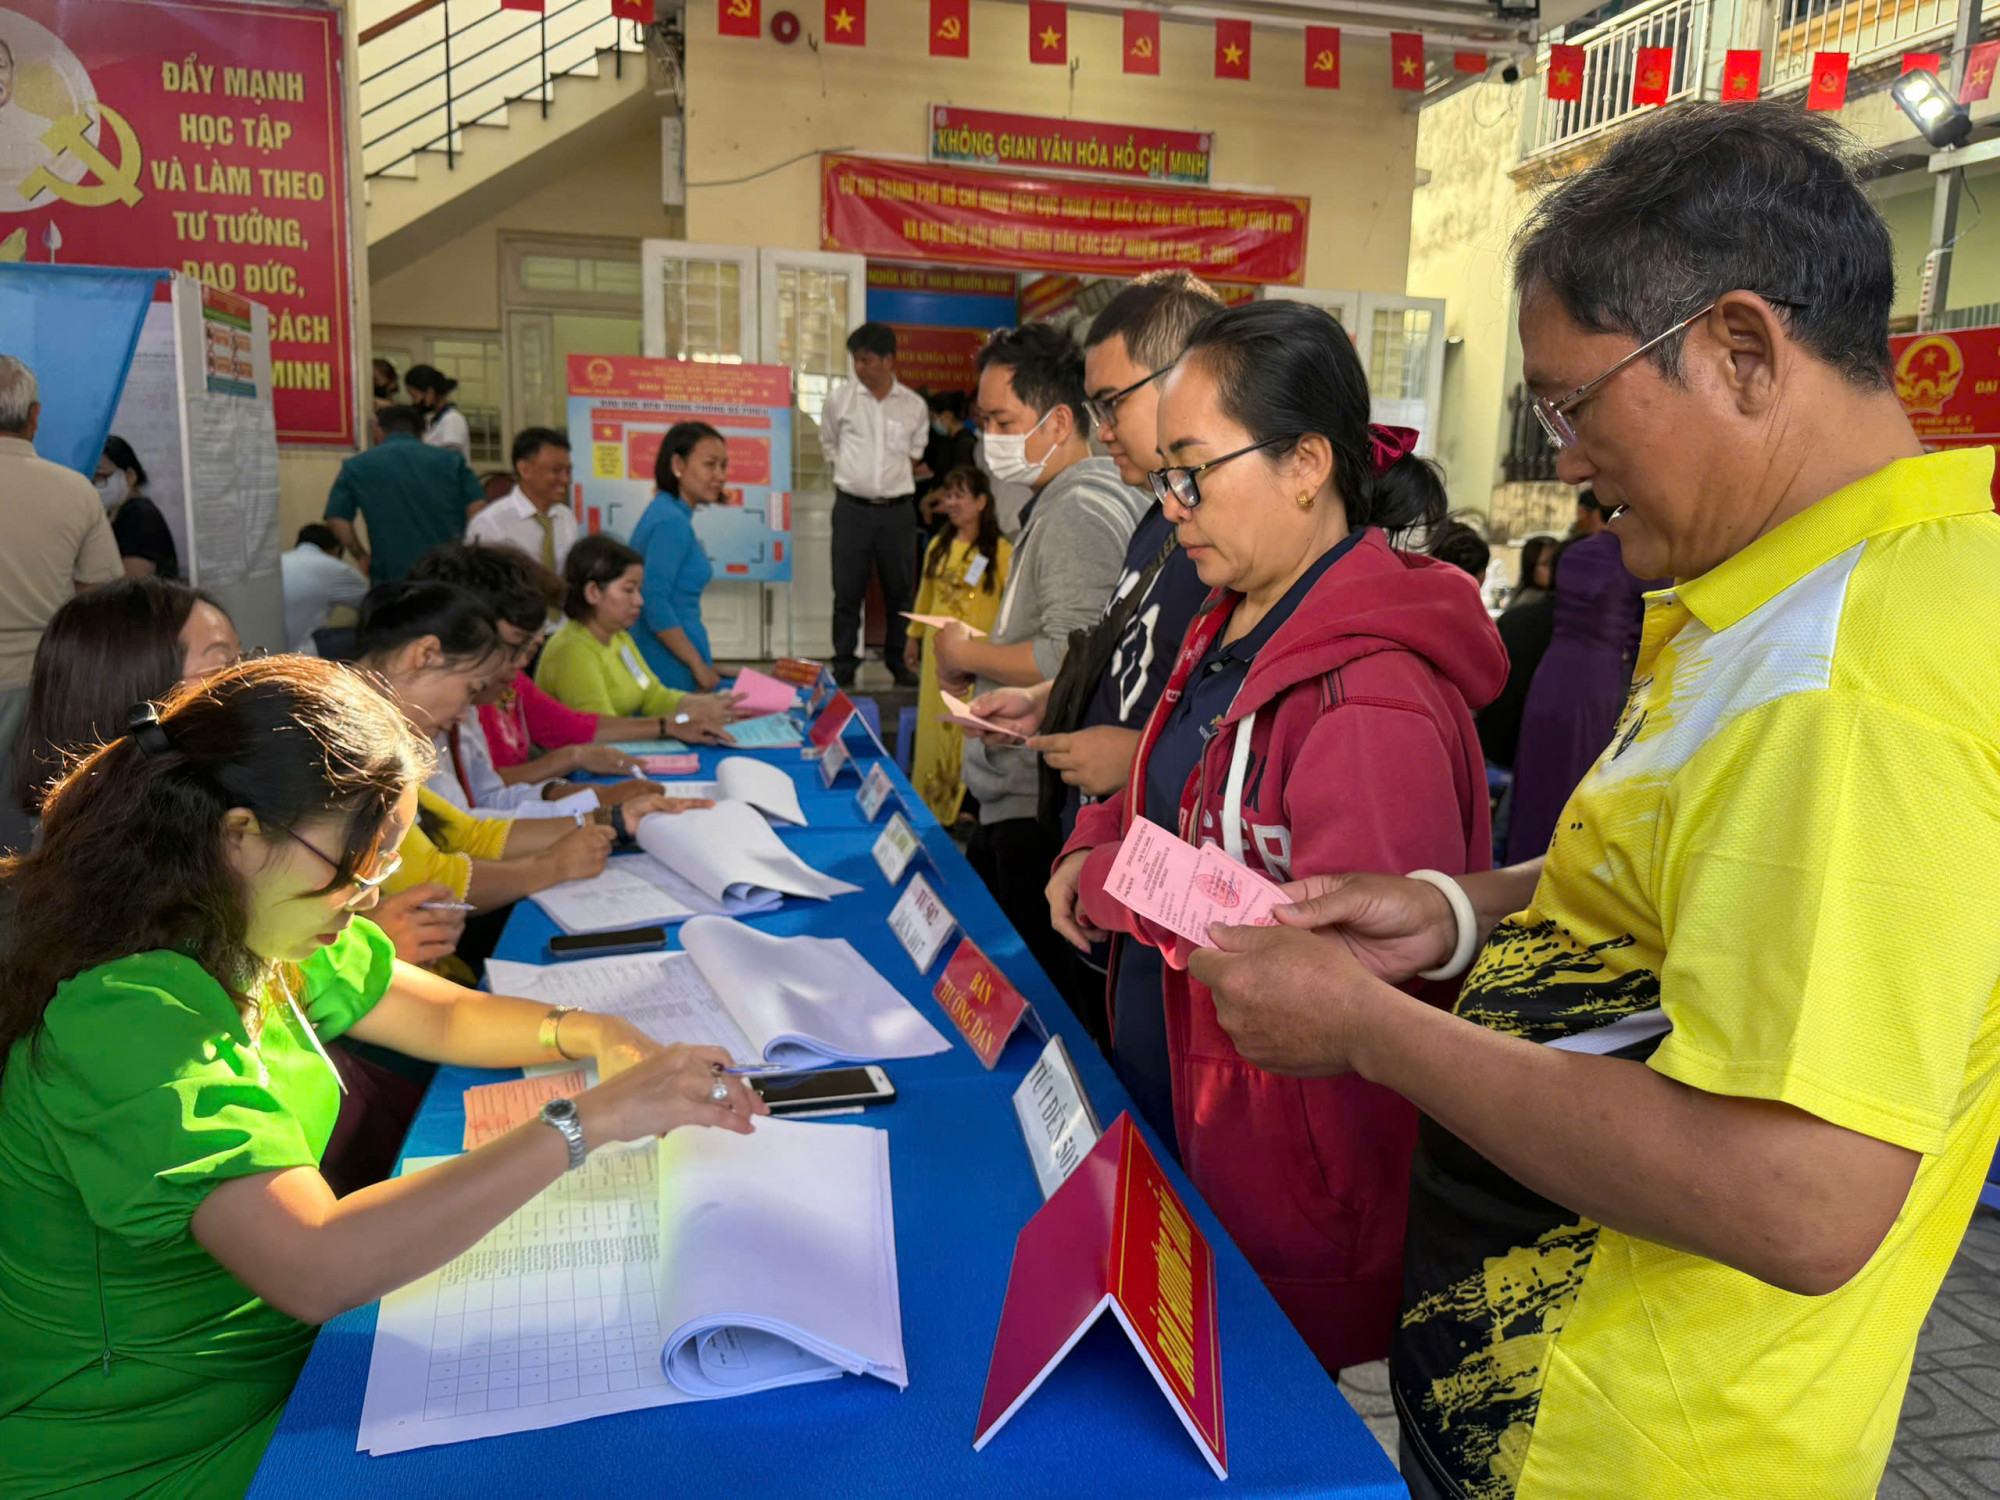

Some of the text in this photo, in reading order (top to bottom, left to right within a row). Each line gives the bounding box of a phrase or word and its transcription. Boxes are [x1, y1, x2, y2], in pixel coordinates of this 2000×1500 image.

[162, 52, 304, 104] ĐẨY MẠNH
[180, 113, 292, 154] HỌC TẬP
[938, 124, 1209, 178] KHÔNG GIAN VĂN HÓA HỒ CHÍ MINH
[151, 156, 325, 201] VÀ LÀM THEO
[172, 207, 309, 251] TƯ TƯỞNG,
[244, 259, 306, 299] ĐỨC,
[1030, 1059, 1054, 1094] TỪ
[1038, 1085, 1054, 1108] 1
[1056, 1135, 1080, 1178] 501
